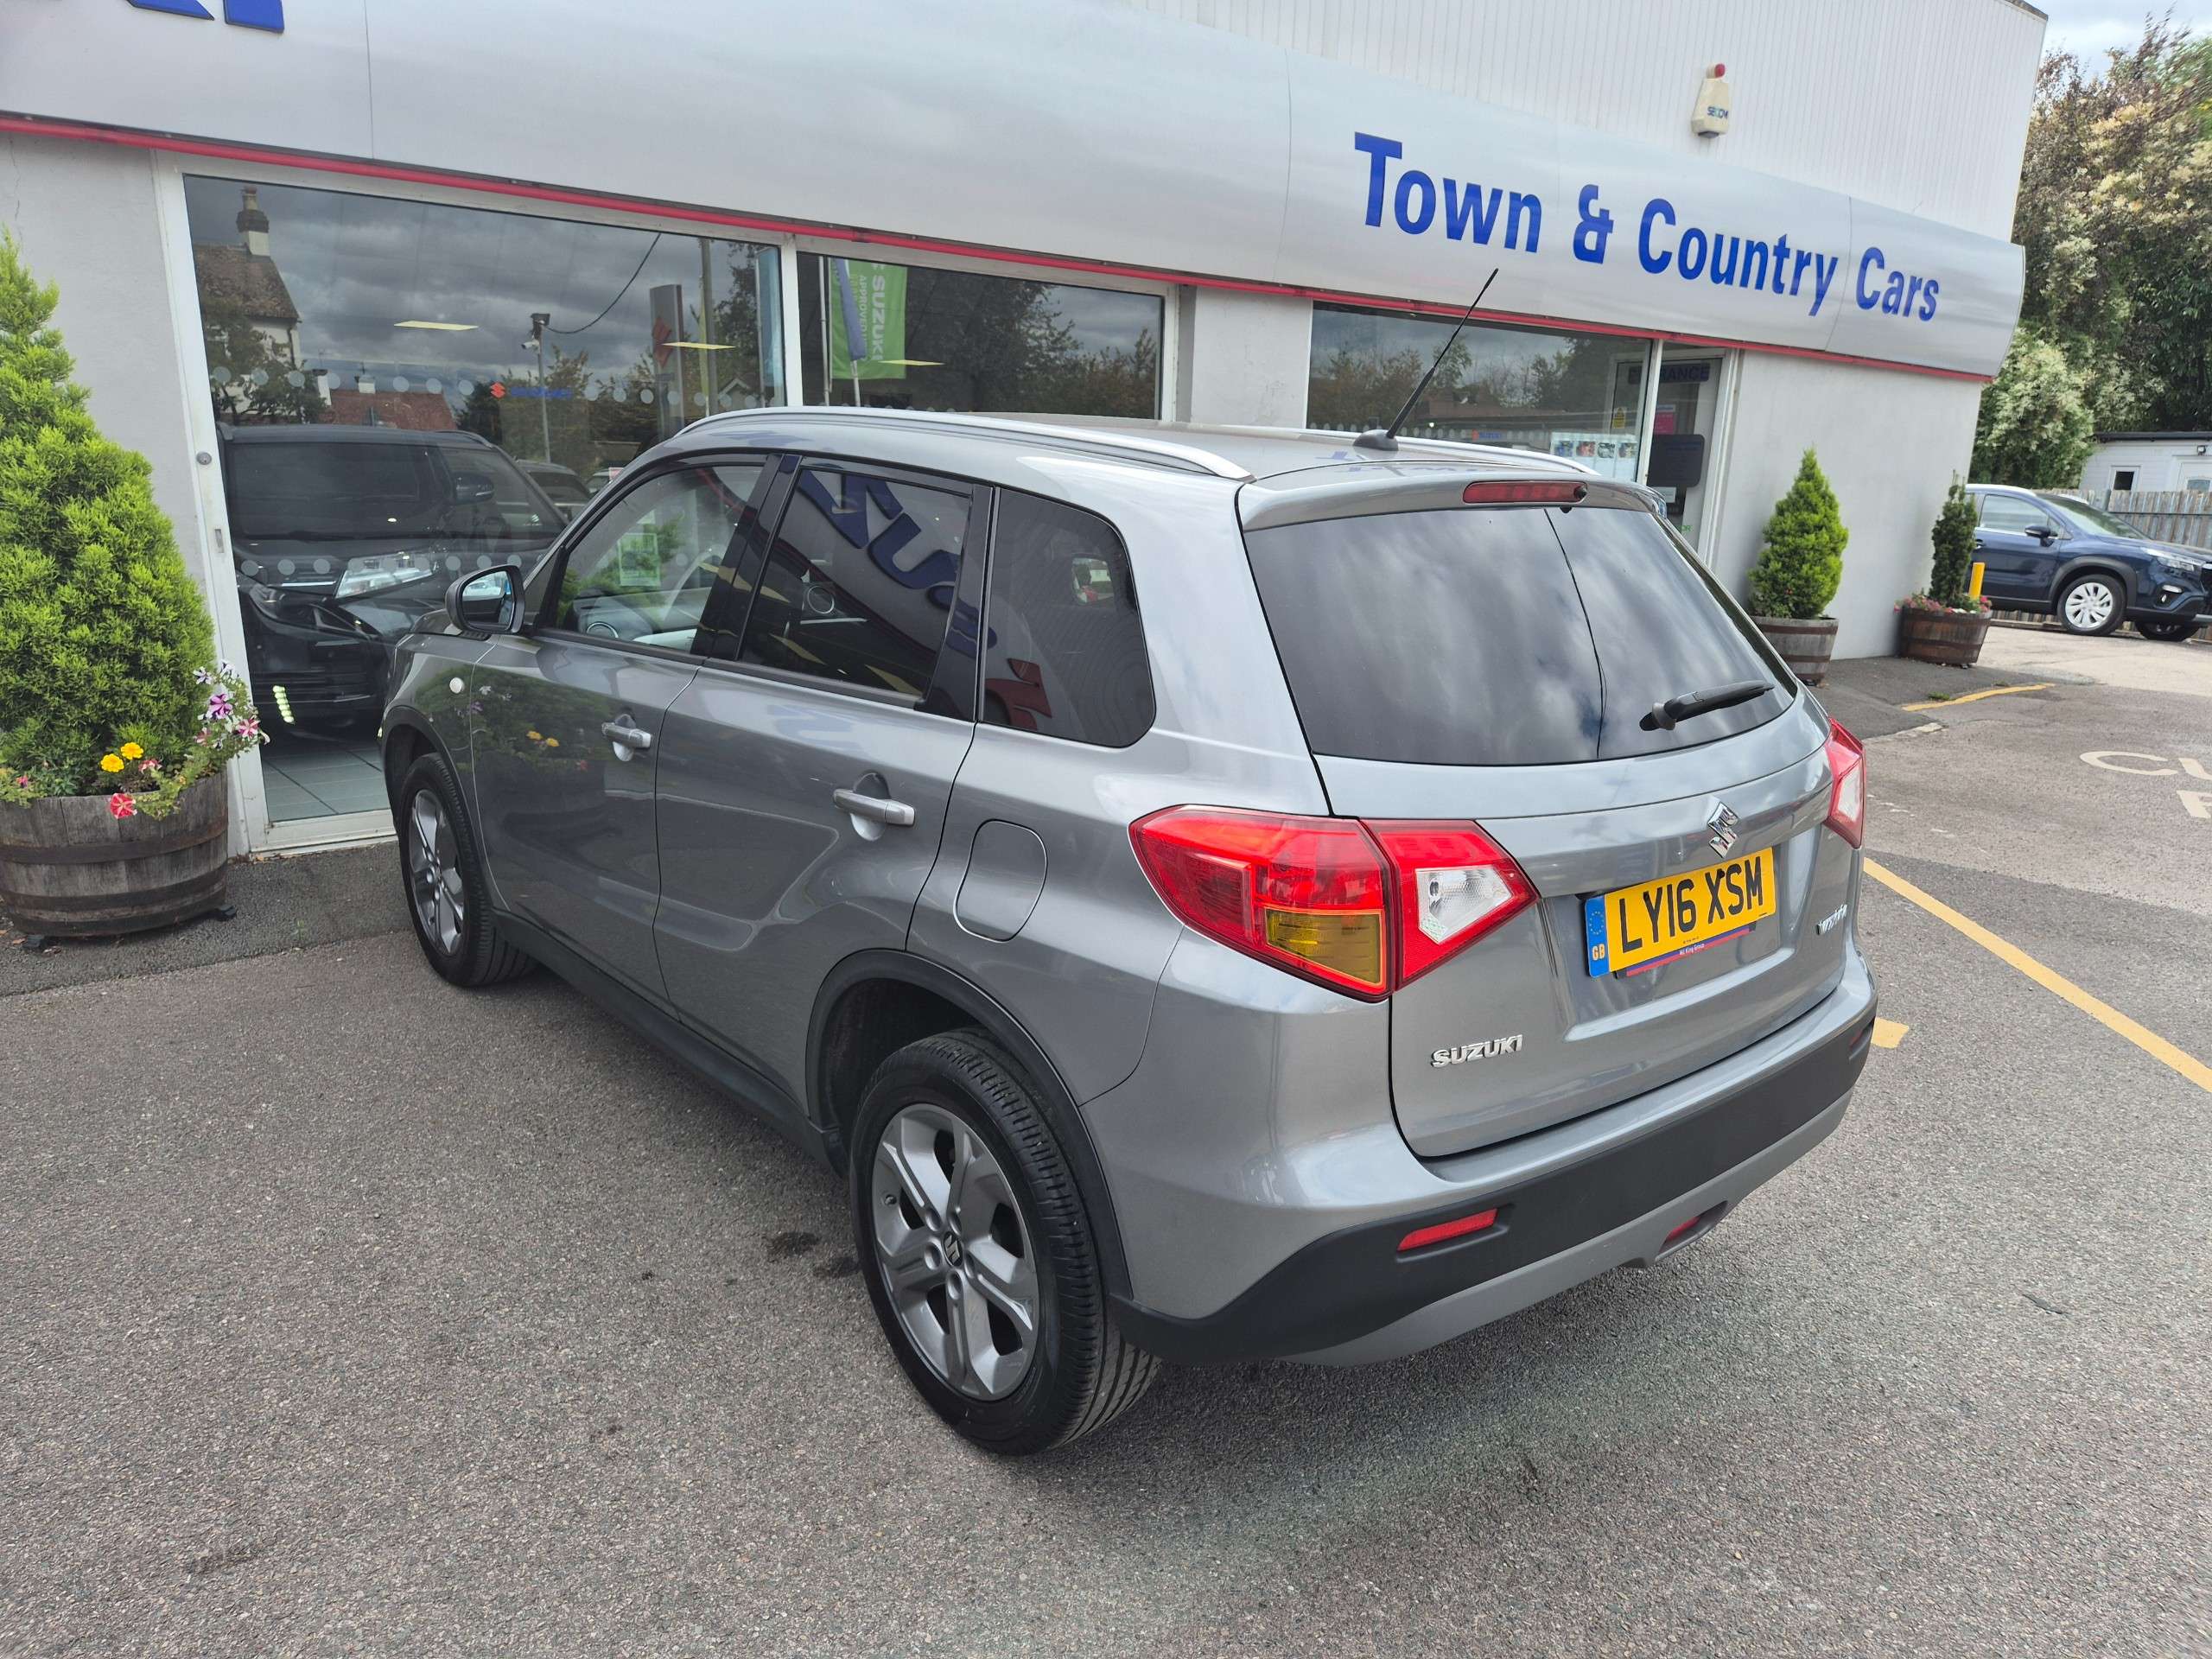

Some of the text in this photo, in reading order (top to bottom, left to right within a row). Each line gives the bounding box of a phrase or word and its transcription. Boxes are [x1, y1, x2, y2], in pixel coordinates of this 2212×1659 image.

[1354, 131, 1940, 321] Town & Country Cars
[1618, 855, 1764, 954] LY16 XSM
[1592, 944, 1605, 962] GB
[1431, 1033, 1523, 1068] SUZUKI
